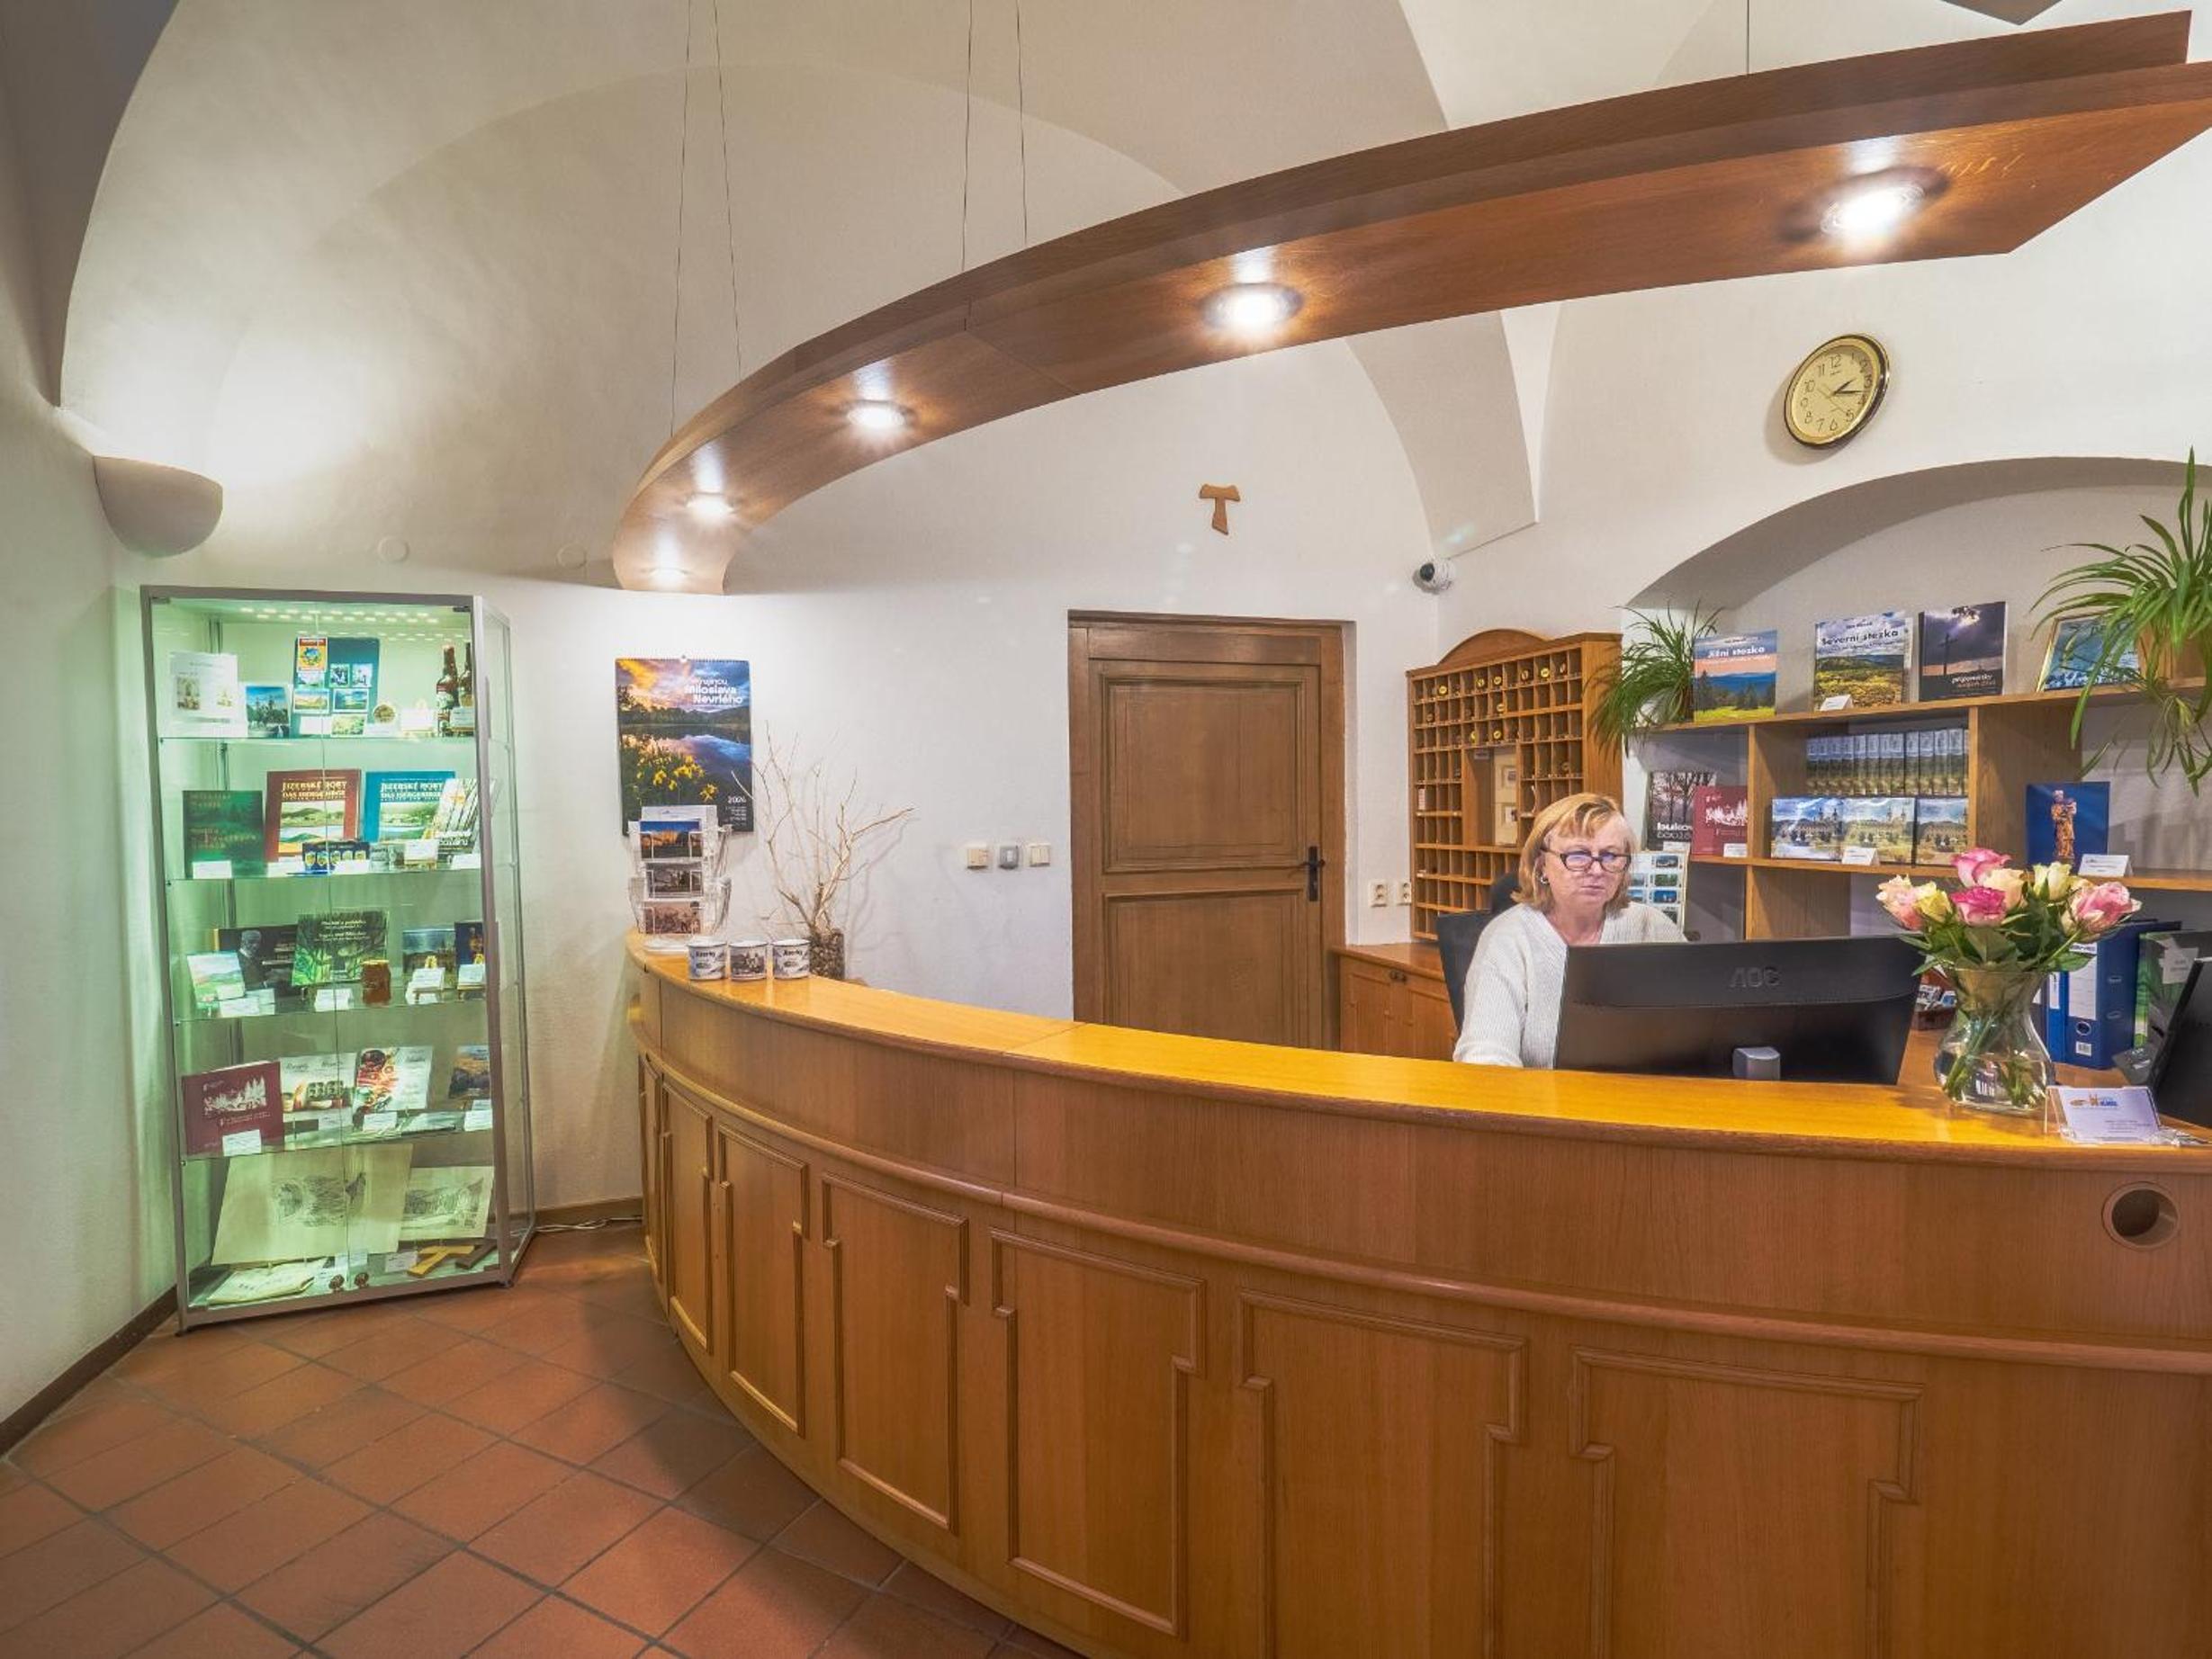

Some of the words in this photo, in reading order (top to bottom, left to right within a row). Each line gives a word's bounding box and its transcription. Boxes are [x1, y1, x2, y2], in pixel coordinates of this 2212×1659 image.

[1830, 354, 1842, 369] 12
[1858, 360, 1868, 374] 2
[1817, 363, 1826, 377] 11
[1804, 380, 1816, 392] 10
[1864, 373, 1873, 389] 3
[1800, 397, 1809, 408] 9
[1804, 411, 1813, 424] 8
[1845, 409, 1855, 422] 5
[1816, 418, 1825, 432] 7
[1829, 418, 1838, 431] 6
[1862, 627, 1899, 645] stezka
[1732, 645, 1765, 656] stezka
[684, 684, 737, 694] Miloslava
[692, 694, 743, 704] Nevrlého
[1728, 966, 1779, 988] AOC
